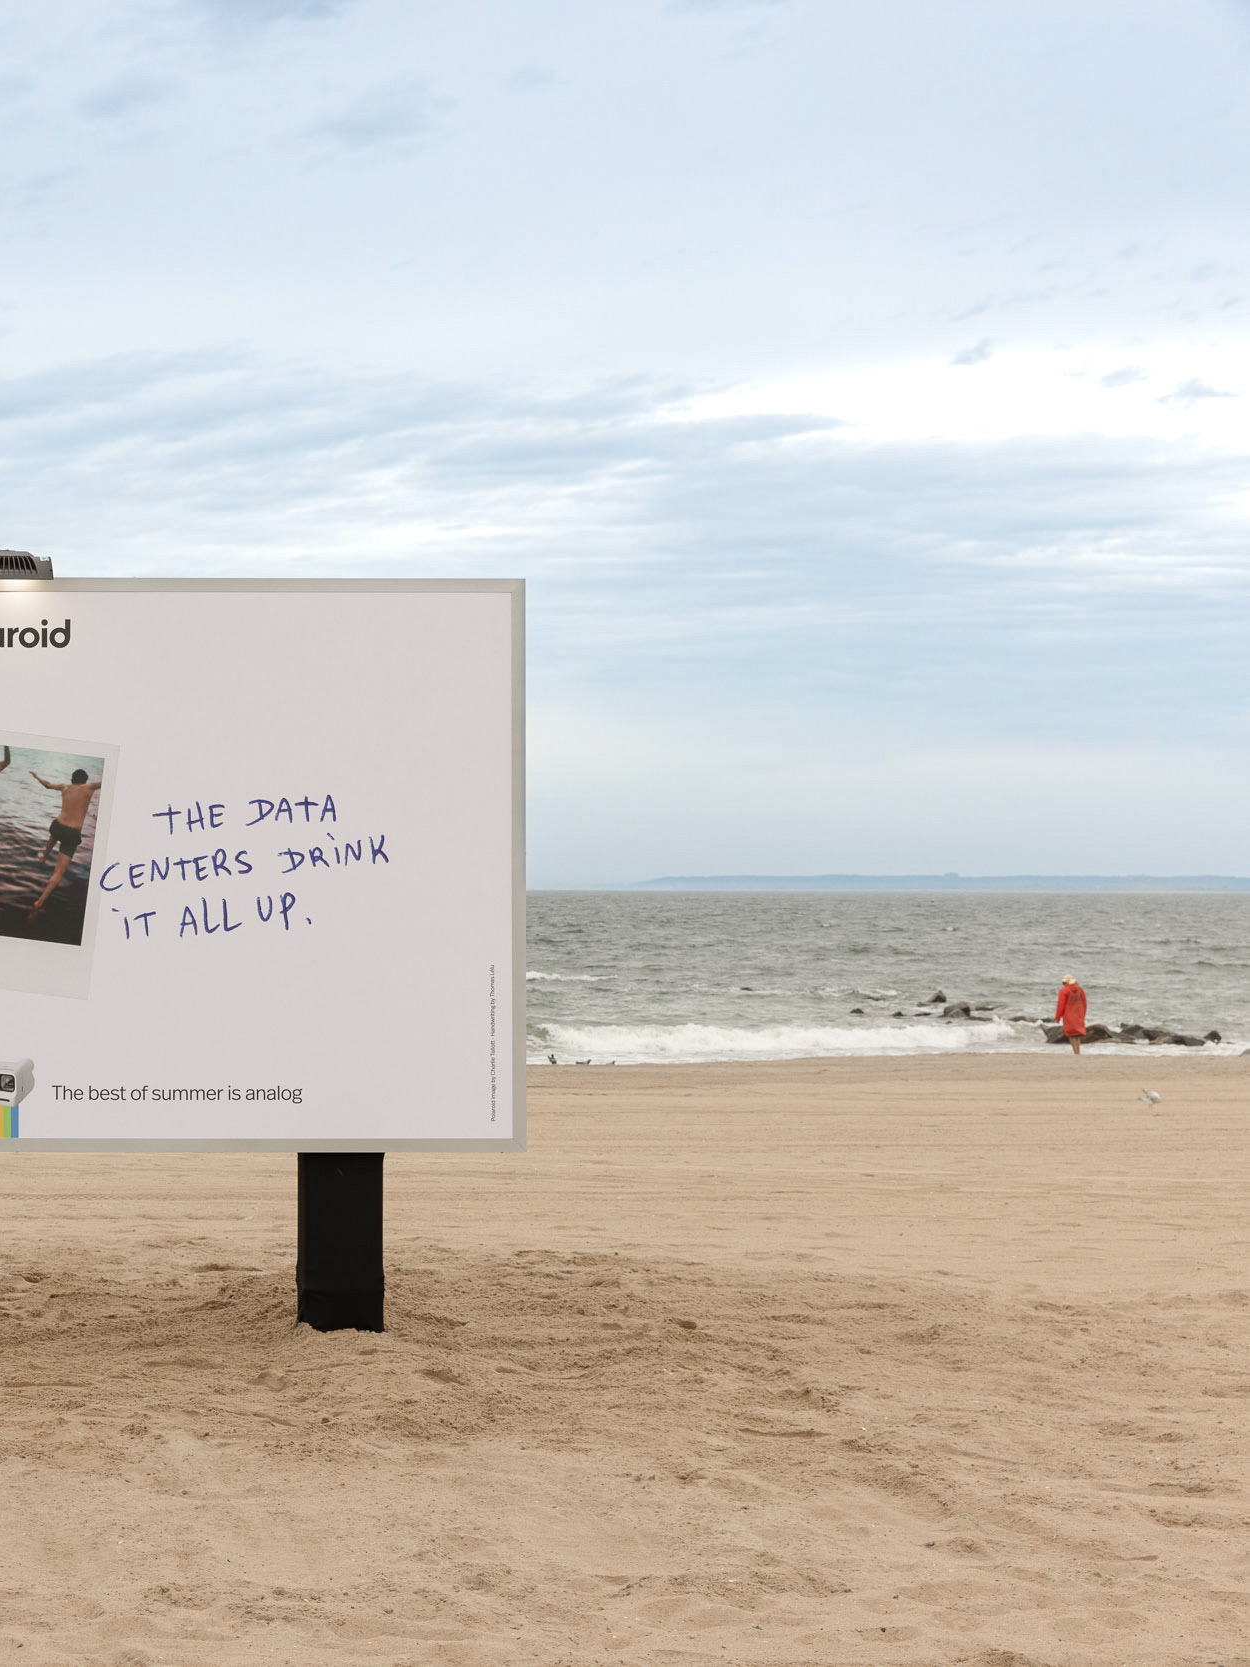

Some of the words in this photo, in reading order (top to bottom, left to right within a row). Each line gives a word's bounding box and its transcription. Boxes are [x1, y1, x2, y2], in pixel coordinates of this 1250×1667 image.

[151, 800, 226, 835] THE
[245, 793, 337, 827] DATA
[98, 848, 253, 892] CENTERS
[179, 896, 243, 939] ALL
[256, 891, 313, 931] UP.
[51, 1084, 84, 1101] The
[88, 1084, 127, 1101] best
[130, 1084, 150, 1101] of
[151, 1088, 224, 1101] summer
[227, 1084, 242, 1101] is
[245, 1084, 303, 1106] analog
